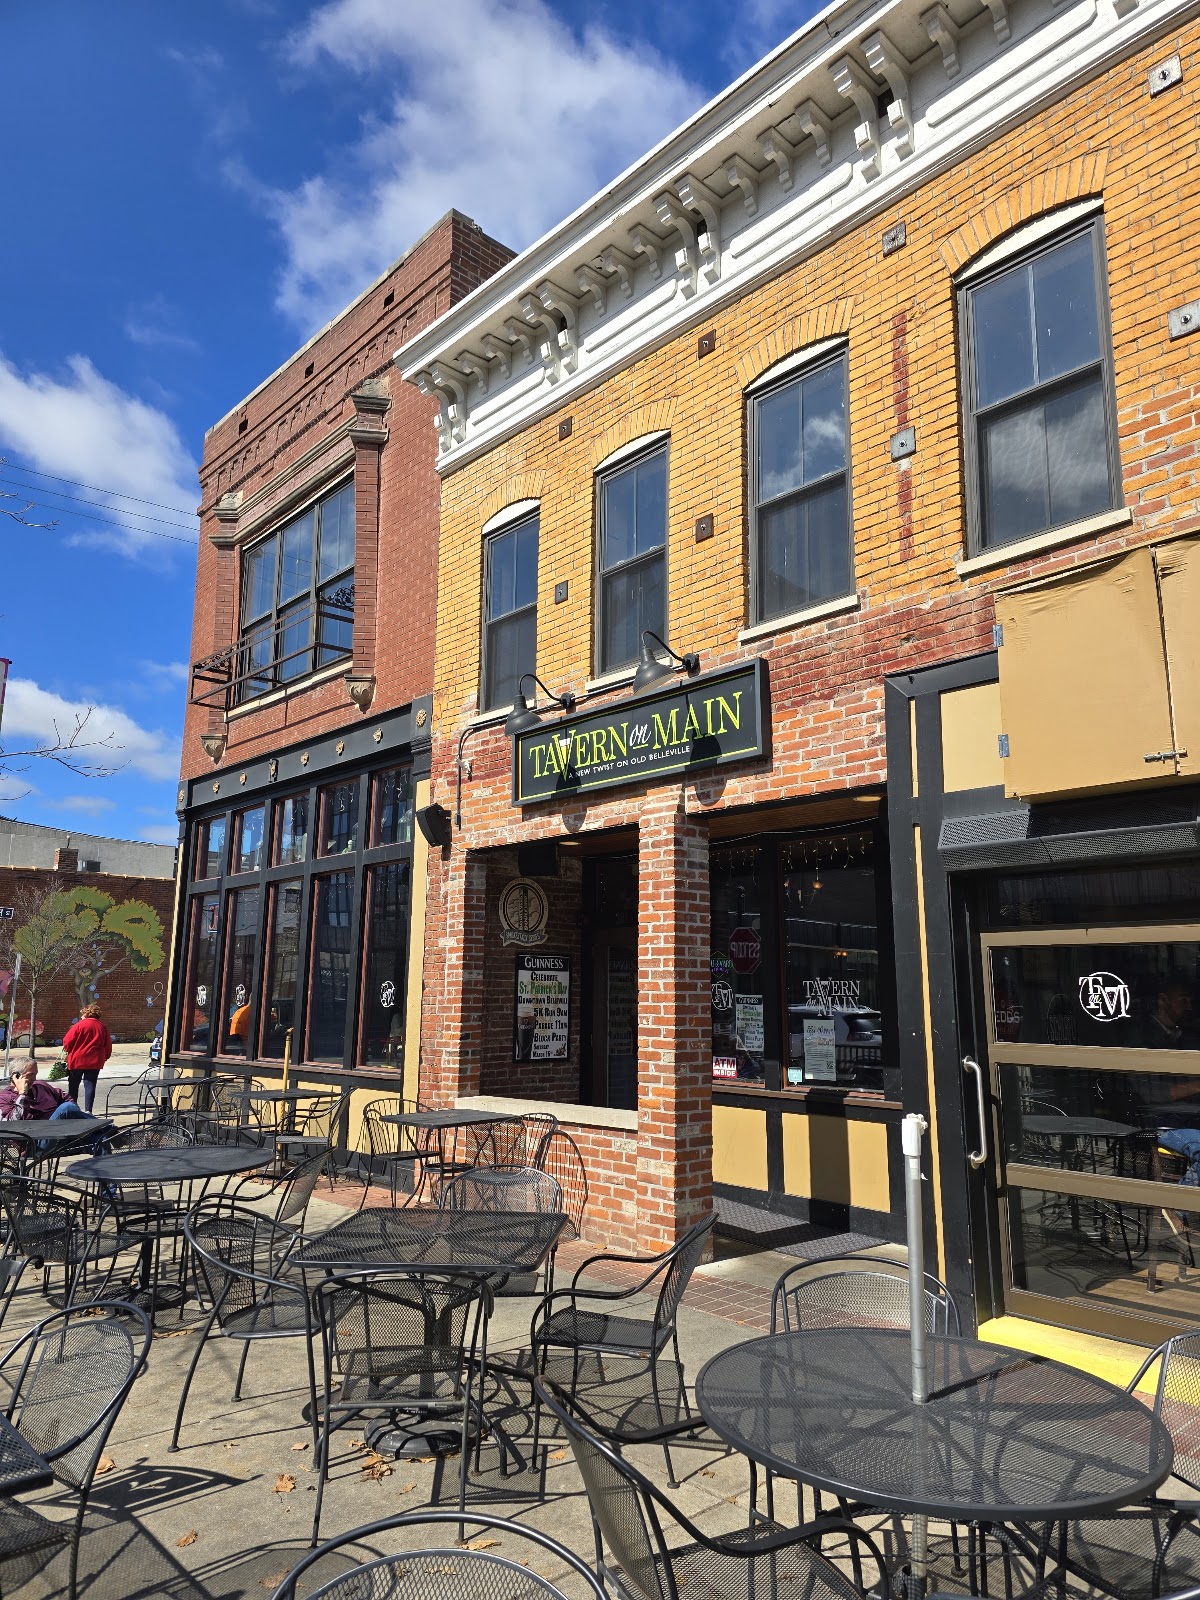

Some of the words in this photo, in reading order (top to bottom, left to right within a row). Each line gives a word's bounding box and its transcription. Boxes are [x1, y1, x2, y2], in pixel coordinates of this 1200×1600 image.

[528, 722, 629, 782] TAVERN
[629, 724, 652, 747] on
[651, 691, 743, 750] MAIN
[575, 767, 591, 777] NEW
[593, 762, 615, 773] TWIST
[616, 759, 629, 768] ON
[630, 755, 647, 765] OLD
[648, 745, 691, 760] BELLEVILLE
[524, 956, 564, 969] GUINNESS
[803, 977, 860, 999] TAVERN
[533, 1007, 544, 1017] 5K
[817, 996, 859, 1017] MAIN
[714, 1057, 736, 1069] ATM
